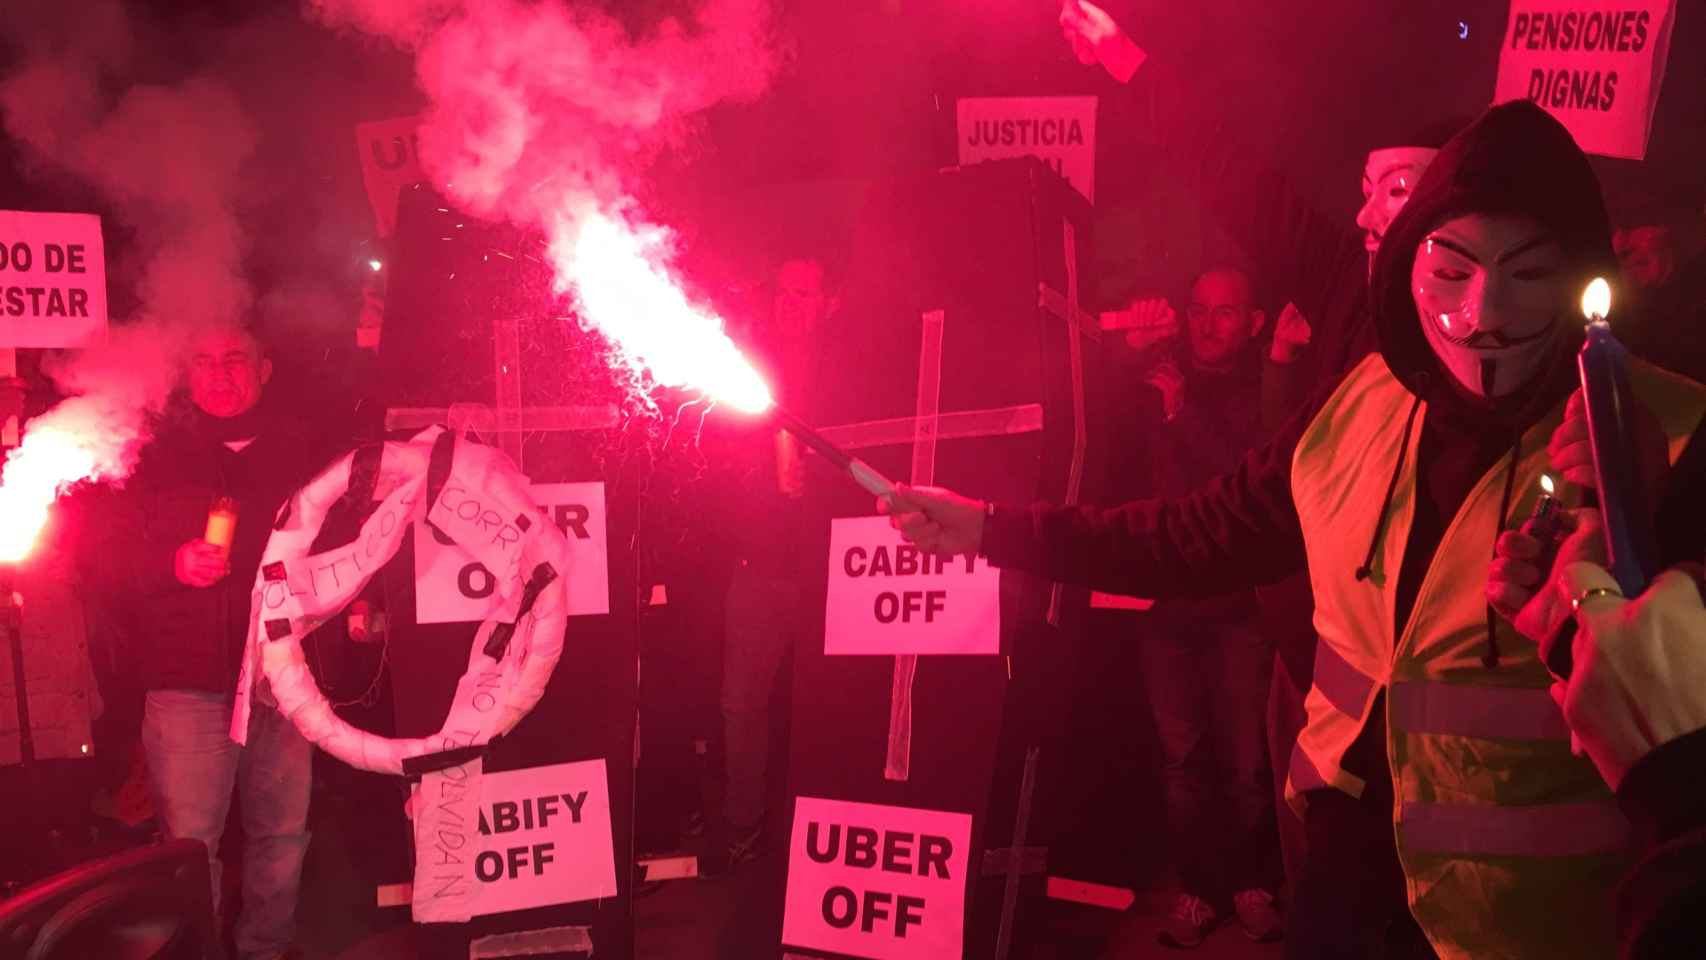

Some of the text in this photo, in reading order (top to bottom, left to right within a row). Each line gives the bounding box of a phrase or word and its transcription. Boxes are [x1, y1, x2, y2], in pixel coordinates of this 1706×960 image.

[1512, 10, 1650, 52] PENSIONES
[1528, 69, 1618, 112] DIGNAS
[968, 118, 1084, 146] JUSTICIA
[44, 243, 87, 274] DE
[0, 286, 89, 317] STAR
[874, 590, 947, 624] OFF
[474, 842, 556, 883] OFF
[806, 821, 953, 880] UBER
[821, 886, 926, 939] OFF
